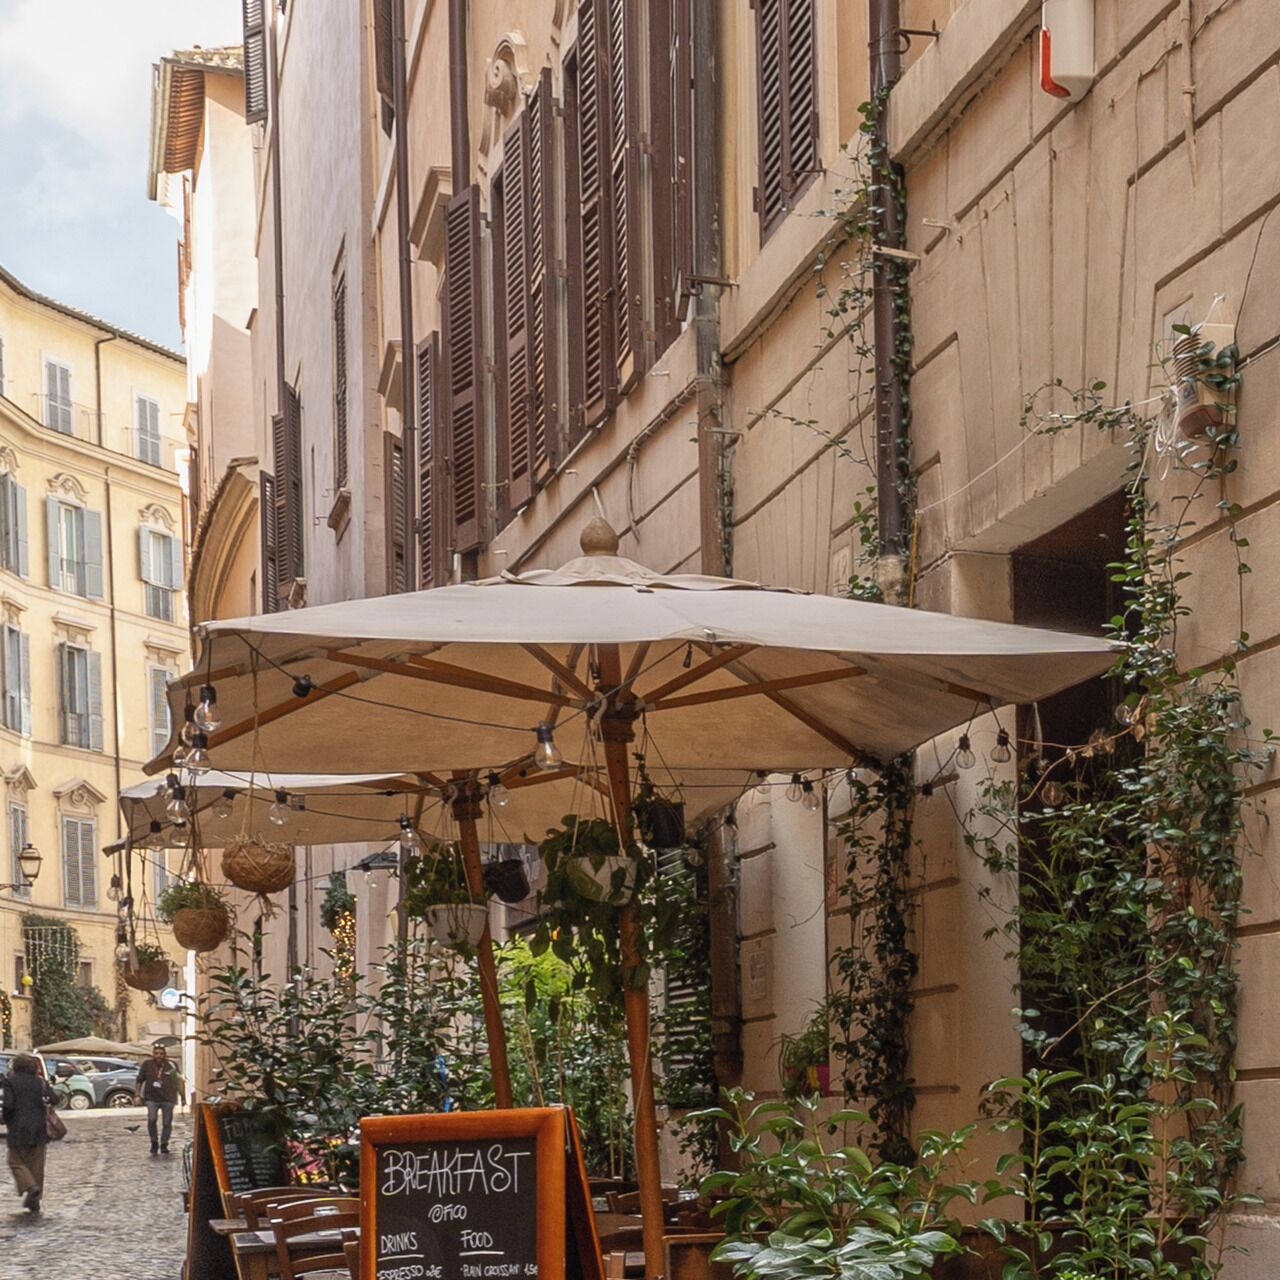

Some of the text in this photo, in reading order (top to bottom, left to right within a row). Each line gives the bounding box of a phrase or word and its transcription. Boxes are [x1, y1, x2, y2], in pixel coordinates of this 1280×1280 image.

[381, 1144, 532, 1198] BREAKFAST
[381, 1232, 418, 1254] DRINKS
[460, 1230, 493, 1248] FOOD
